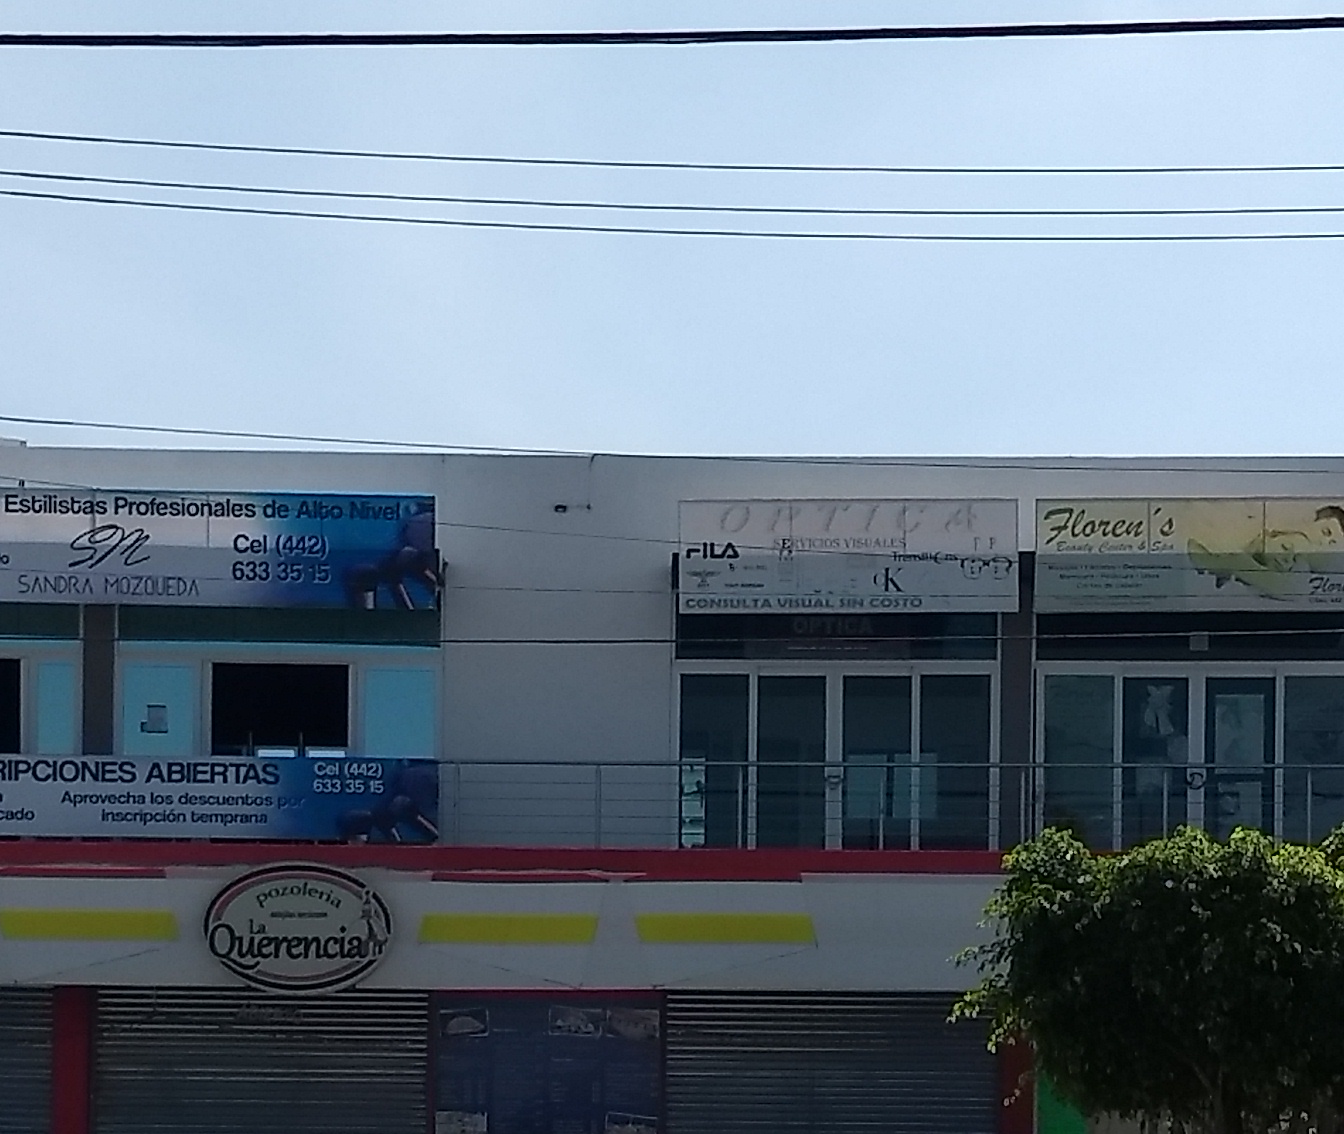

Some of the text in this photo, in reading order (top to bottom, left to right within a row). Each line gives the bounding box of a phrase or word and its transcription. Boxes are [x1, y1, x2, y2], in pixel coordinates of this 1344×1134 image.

[3, 494, 108, 516] Estilistas
[113, 495, 257, 519] Profesionales
[262, 497, 290, 519] de
[296, 499, 344, 520] Alto
[349, 500, 401, 522] Nivel
[232, 533, 330, 559] Cel (442)
[685, 542, 740, 560] FILA
[231, 560, 332, 585] 633 35 15
[17, 574, 94, 595] SANDRA
[685, 597, 923, 610] CONSULTA VISUAL SIN COSTO
[144, 760, 281, 786] ABIERTAS
[313, 761, 384, 779] Cel (442)
[312, 778, 385, 795] 633 35 15
[60, 790, 147, 807] Aprovecha
[150, 791, 176, 806] los
[178, 791, 274, 808] descuentos
[190, 810, 269, 827] temprana
[249, 917, 268, 935] La
[208, 922, 367, 971] Querencia
